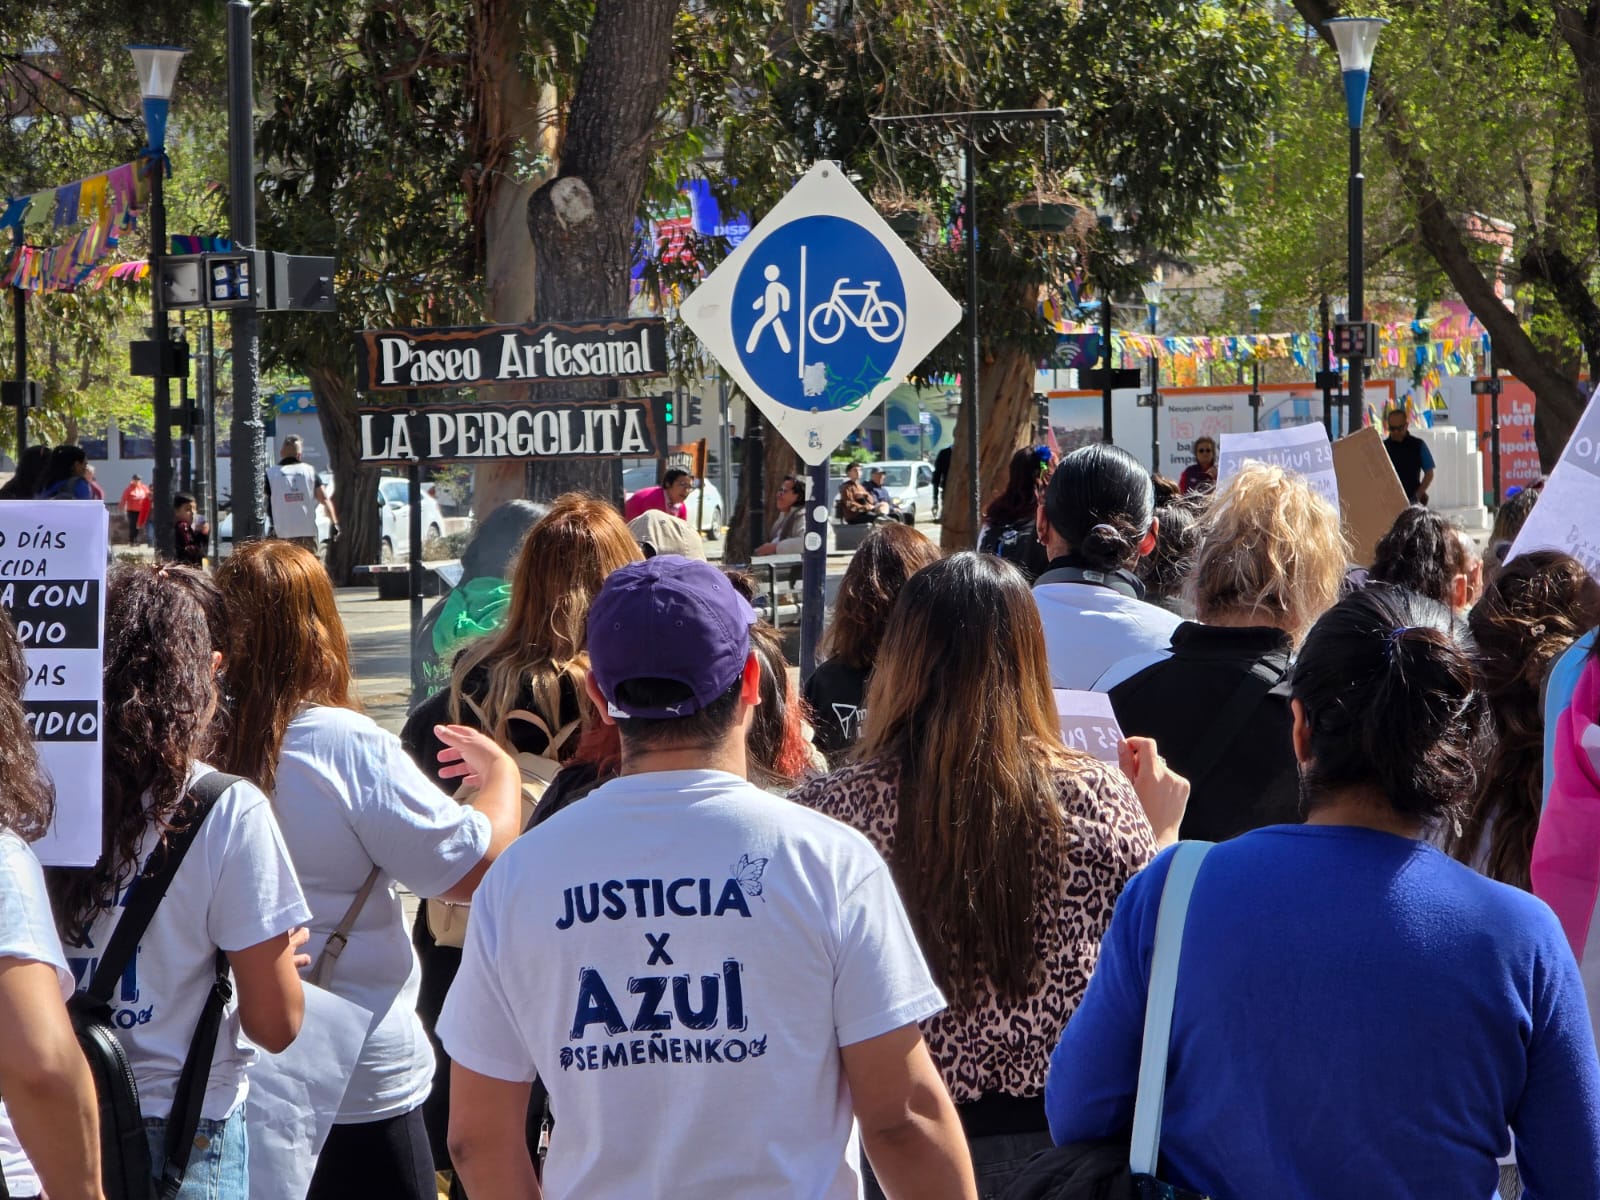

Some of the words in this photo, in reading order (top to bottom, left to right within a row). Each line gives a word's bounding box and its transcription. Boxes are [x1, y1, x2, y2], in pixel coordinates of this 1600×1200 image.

[380, 338, 481, 385] Paseo
[496, 328, 654, 379] Artesanal
[360, 413, 418, 461] LA
[426, 408, 649, 458] PERGOLITA
[18, 524, 67, 549] DÍAS
[28, 580, 89, 607] CON
[555, 877, 753, 931] JUSTICIA
